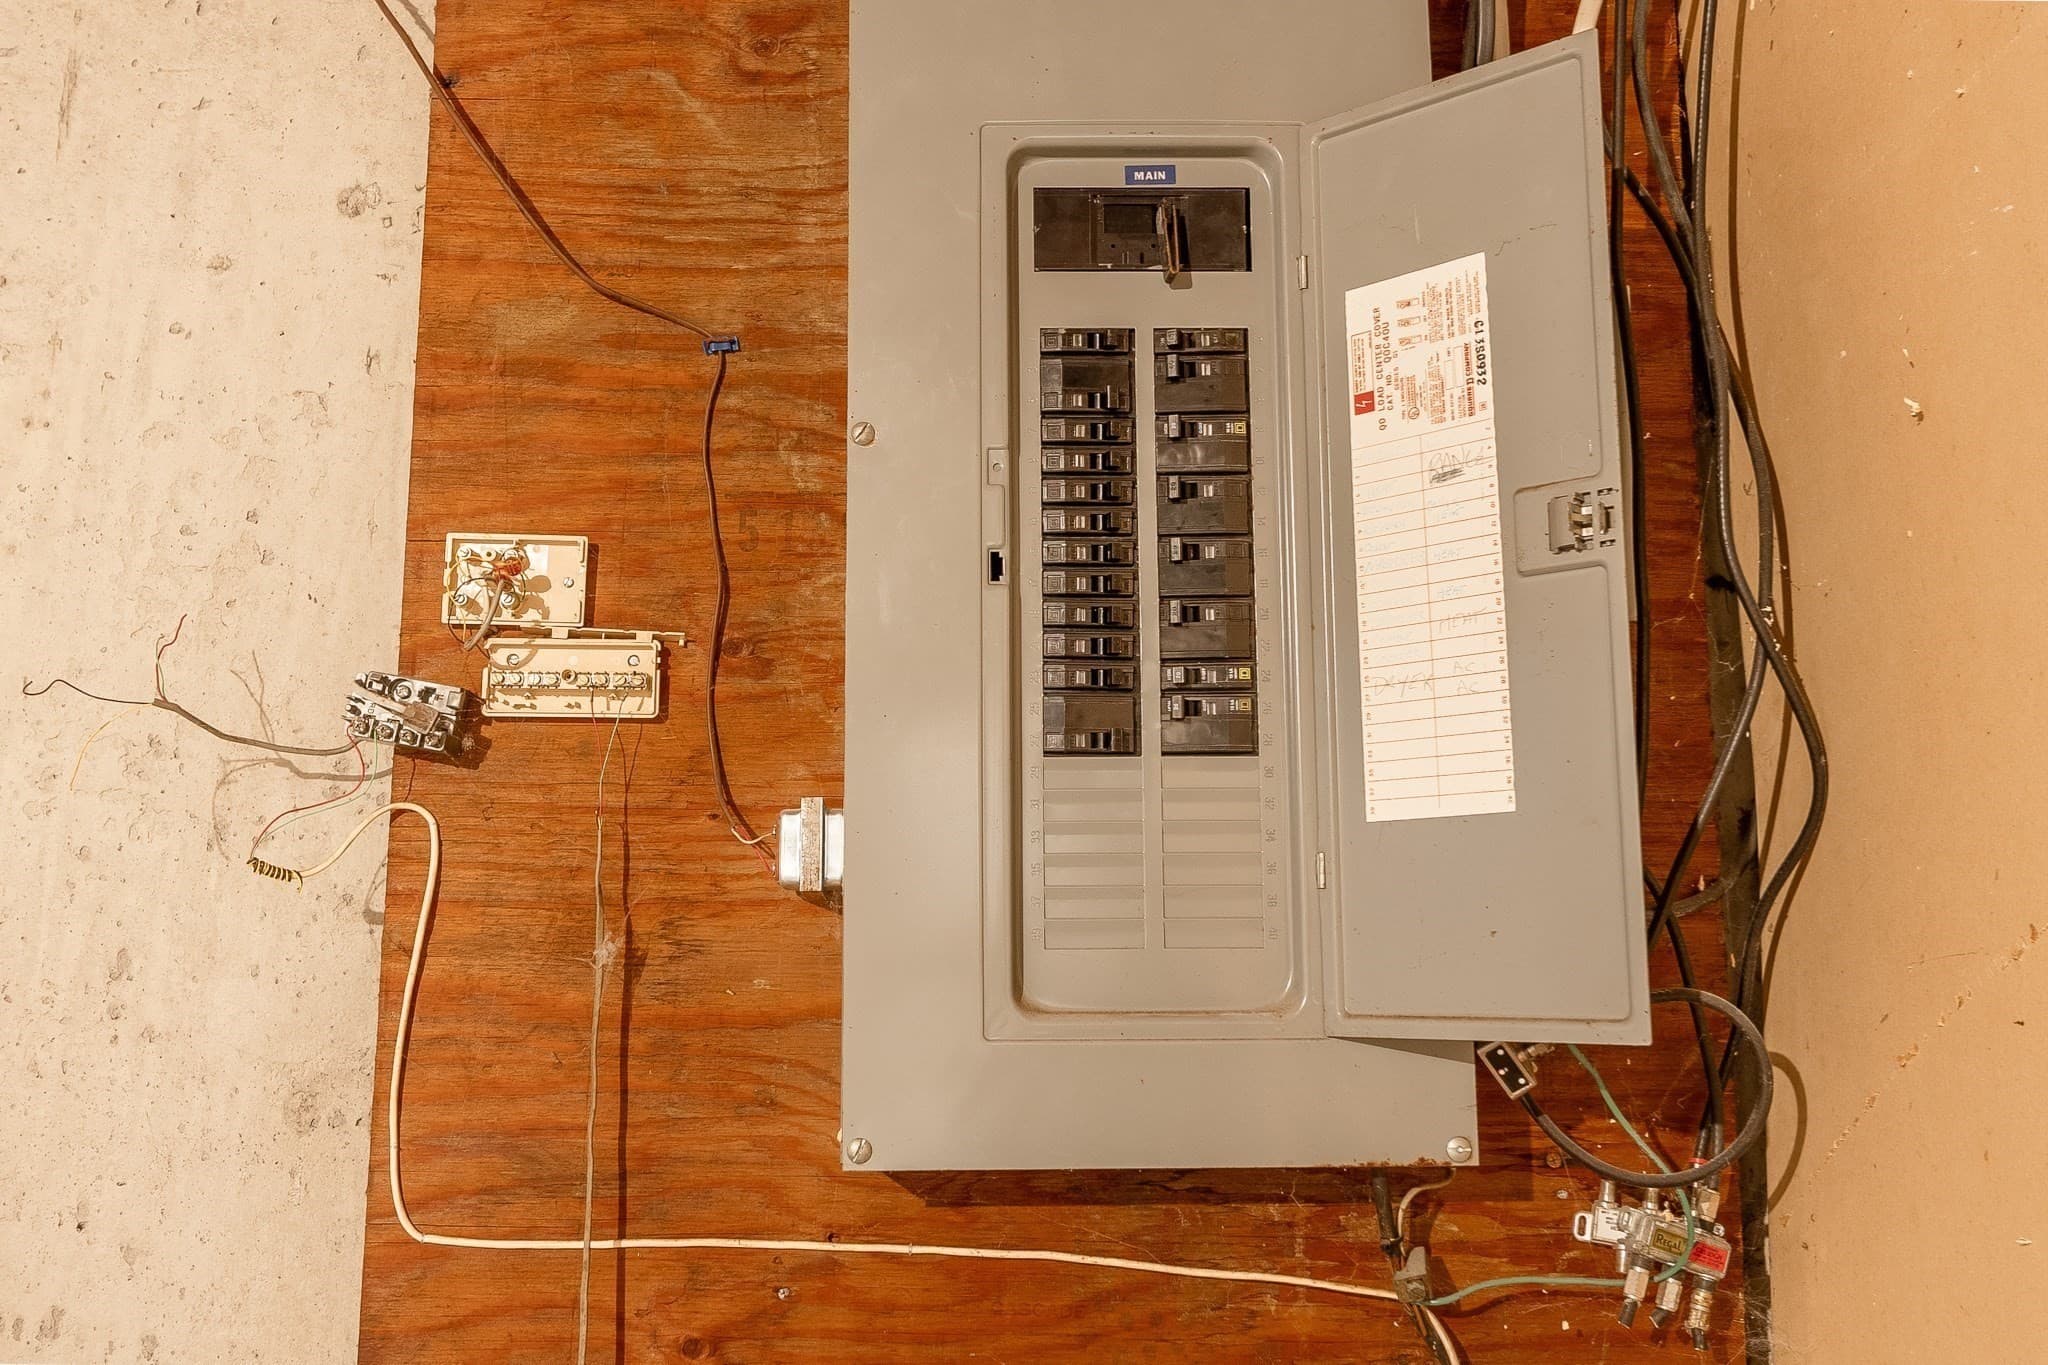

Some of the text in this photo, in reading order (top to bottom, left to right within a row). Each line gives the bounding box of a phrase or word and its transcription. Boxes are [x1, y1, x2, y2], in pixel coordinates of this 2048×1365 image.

[1134, 170, 1166, 181] MAIN
[1372, 307, 1382, 338] COVER
[1374, 344, 1384, 380] CENTER
[1376, 386, 1386, 412] LOAD
